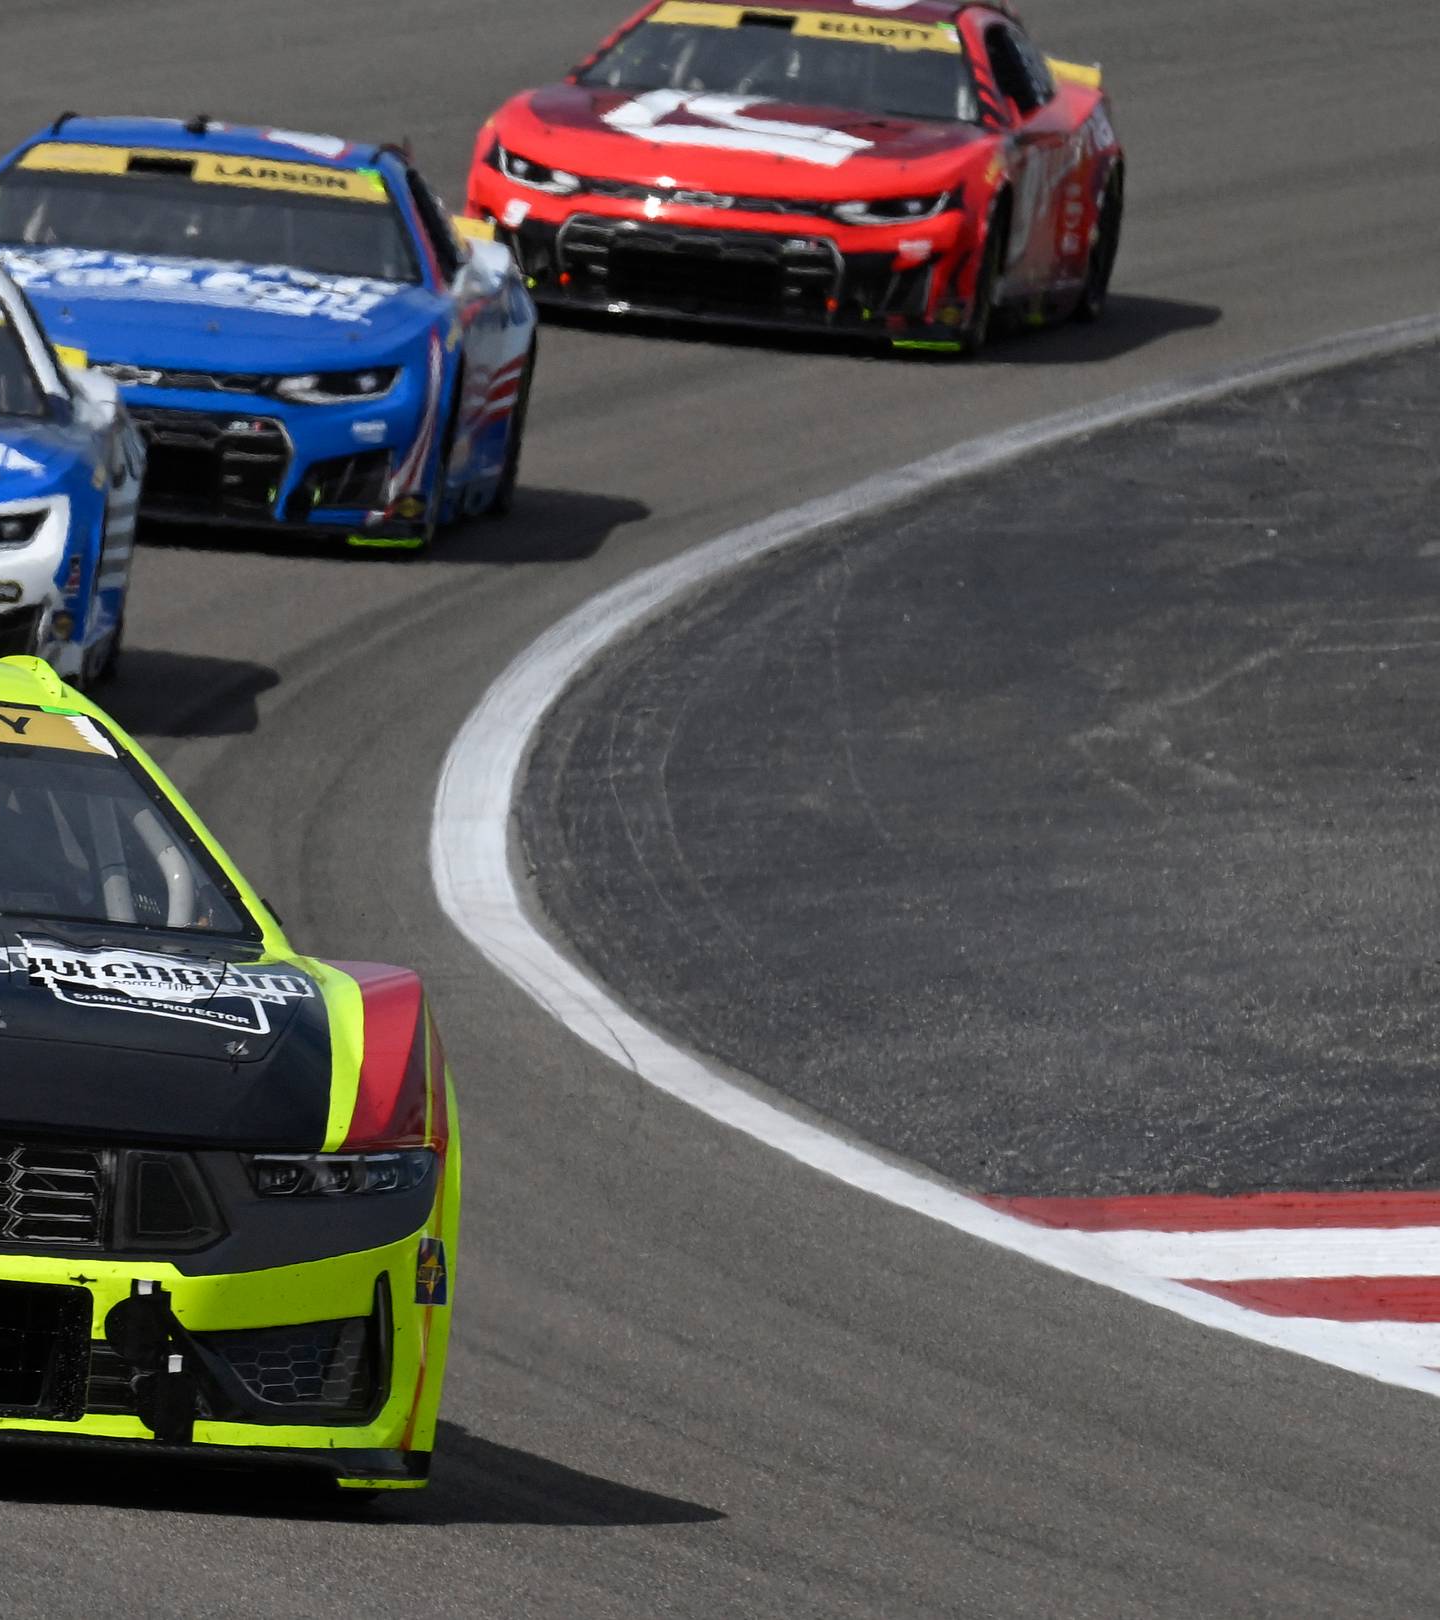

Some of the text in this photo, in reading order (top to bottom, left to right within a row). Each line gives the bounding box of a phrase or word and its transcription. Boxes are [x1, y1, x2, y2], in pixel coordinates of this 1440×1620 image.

[818, 20, 934, 41] ELLIOTT
[214, 162, 348, 191] LARSON
[72, 992, 251, 1025] SHINGLE PROTECTOR
